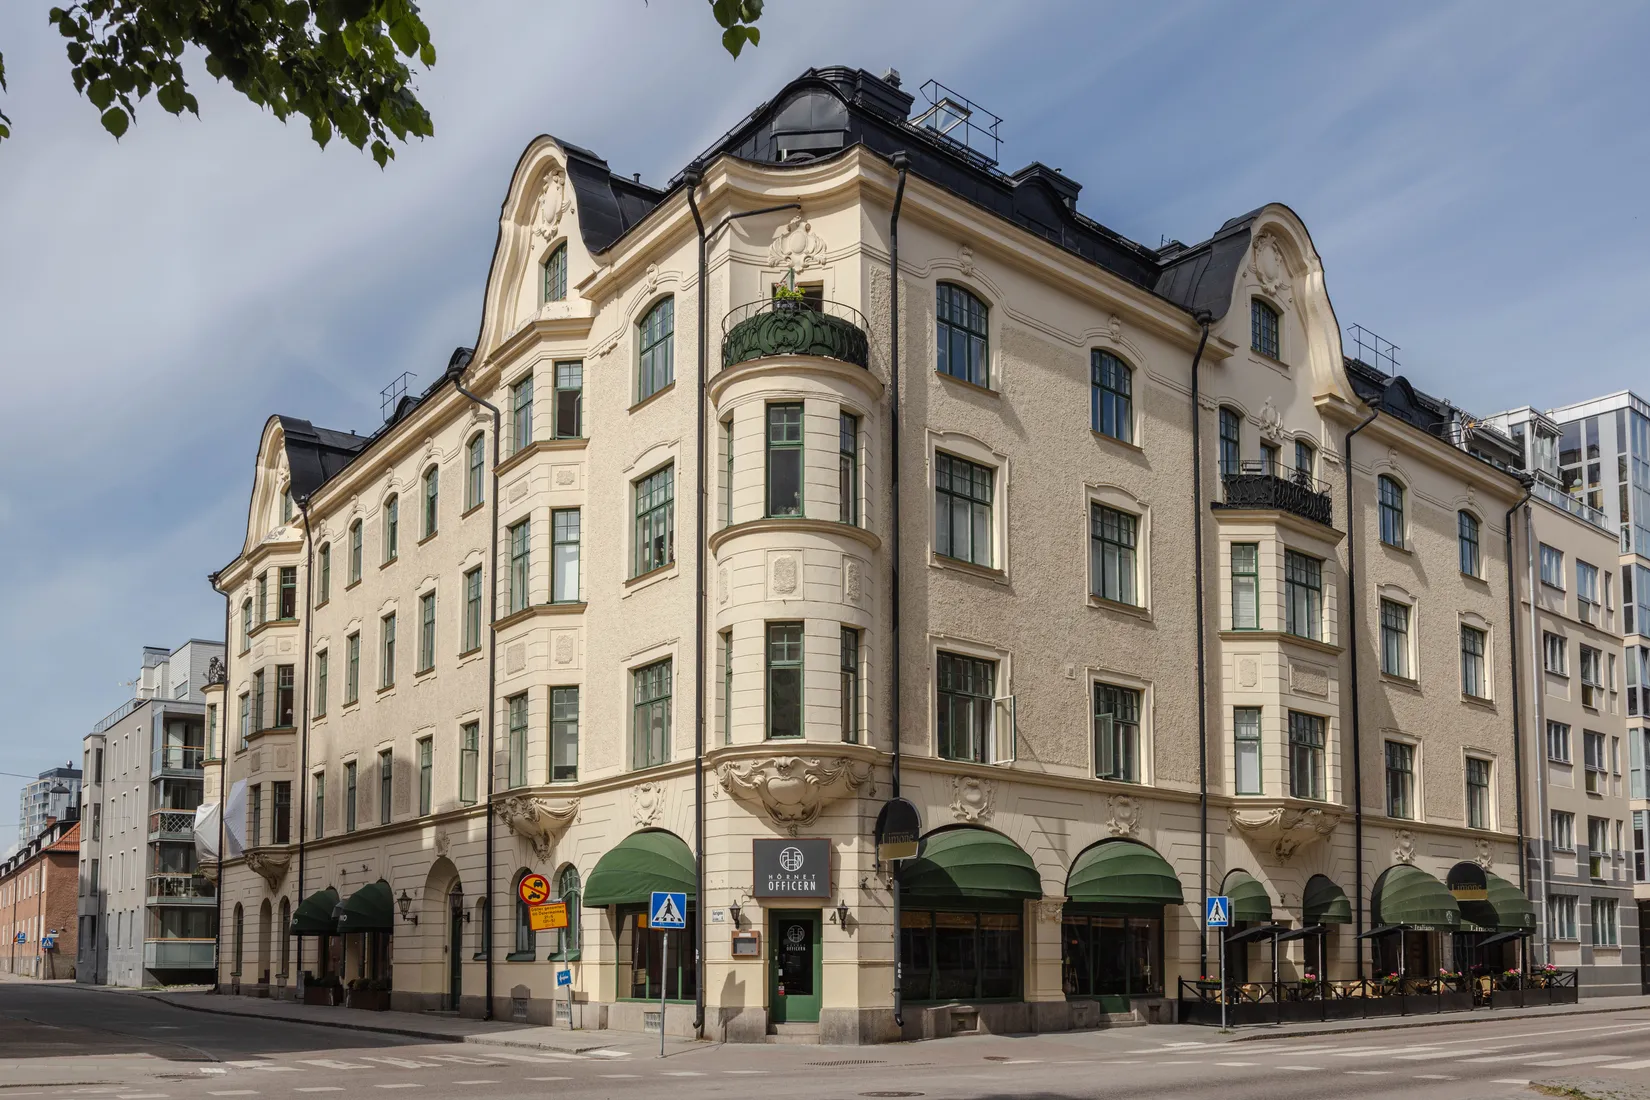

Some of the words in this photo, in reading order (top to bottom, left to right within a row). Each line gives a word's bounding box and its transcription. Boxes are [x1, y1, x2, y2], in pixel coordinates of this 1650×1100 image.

[768, 881, 816, 891] OFFICERN
[829, 911, 837, 925] 4
[1470, 924, 1496, 932] Limone
